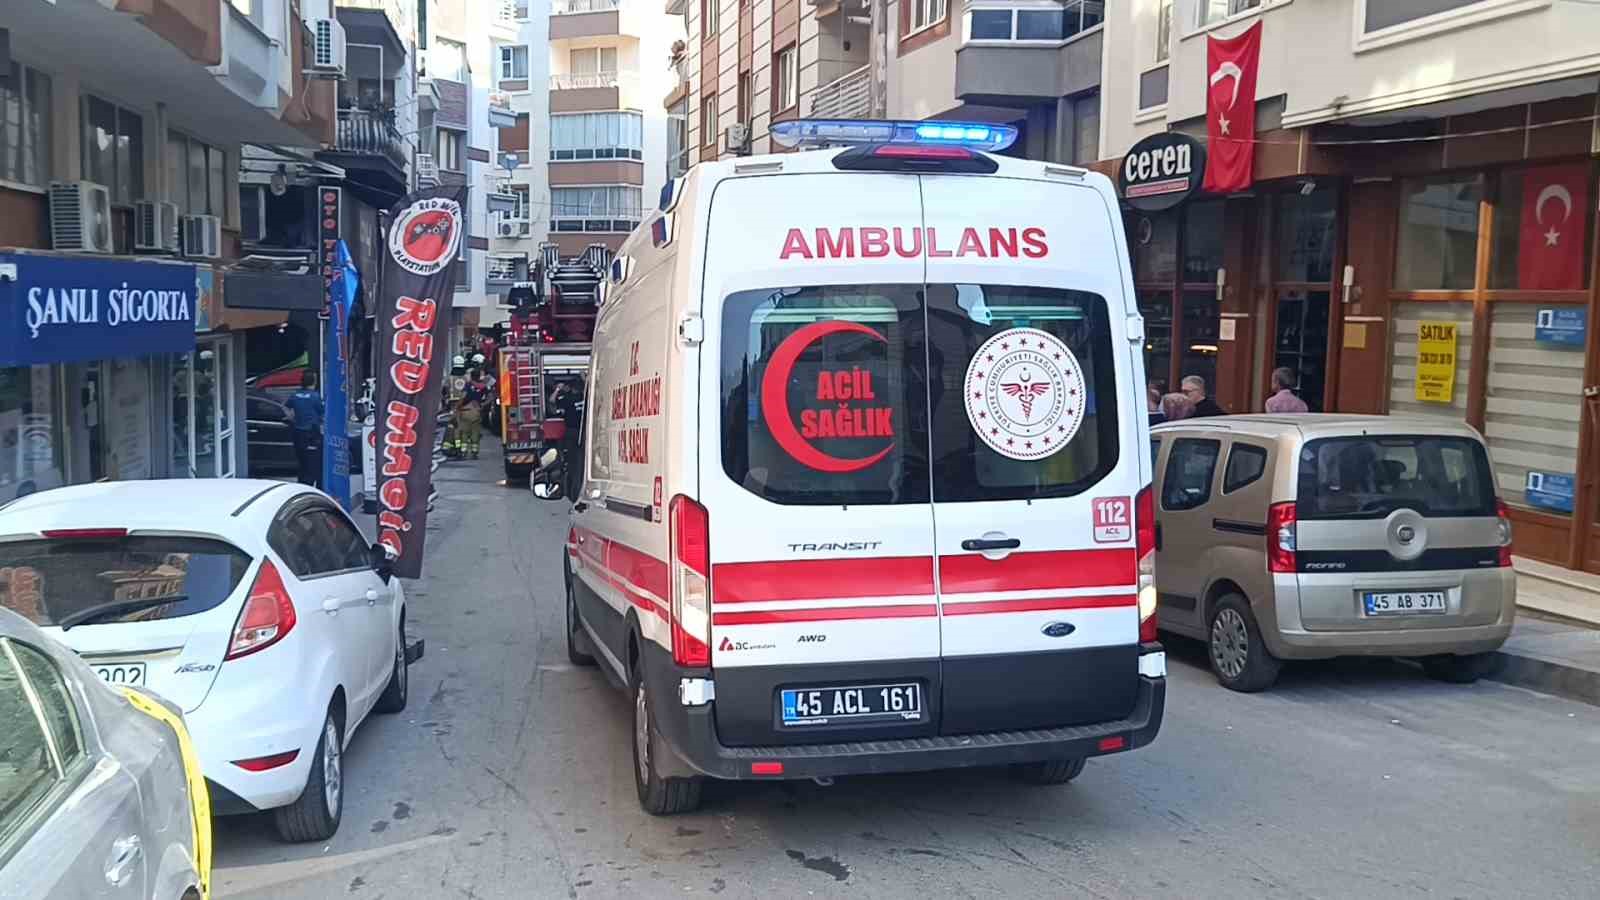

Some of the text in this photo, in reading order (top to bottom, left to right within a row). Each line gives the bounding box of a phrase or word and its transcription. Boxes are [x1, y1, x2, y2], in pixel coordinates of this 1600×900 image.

[1125, 144, 1191, 182] ceren
[323, 192, 337, 229] OTO
[779, 227, 1049, 260] AMBULANS
[26, 287, 99, 338] ŞANLI
[107, 282, 190, 326] SİGORTA
[391, 296, 437, 393] RED
[816, 366, 875, 401] ACİL
[801, 403, 894, 439] SAĞLIK
[1097, 501, 1126, 524] 112
[788, 541, 883, 551] TRANSIT
[1374, 595, 1390, 609] 45
[1397, 594, 1413, 609] AB
[1420, 594, 1443, 608] 371
[797, 634, 827, 643] AWD
[797, 692, 822, 716] 45
[833, 689, 871, 714] ACL
[881, 687, 915, 711] 161
